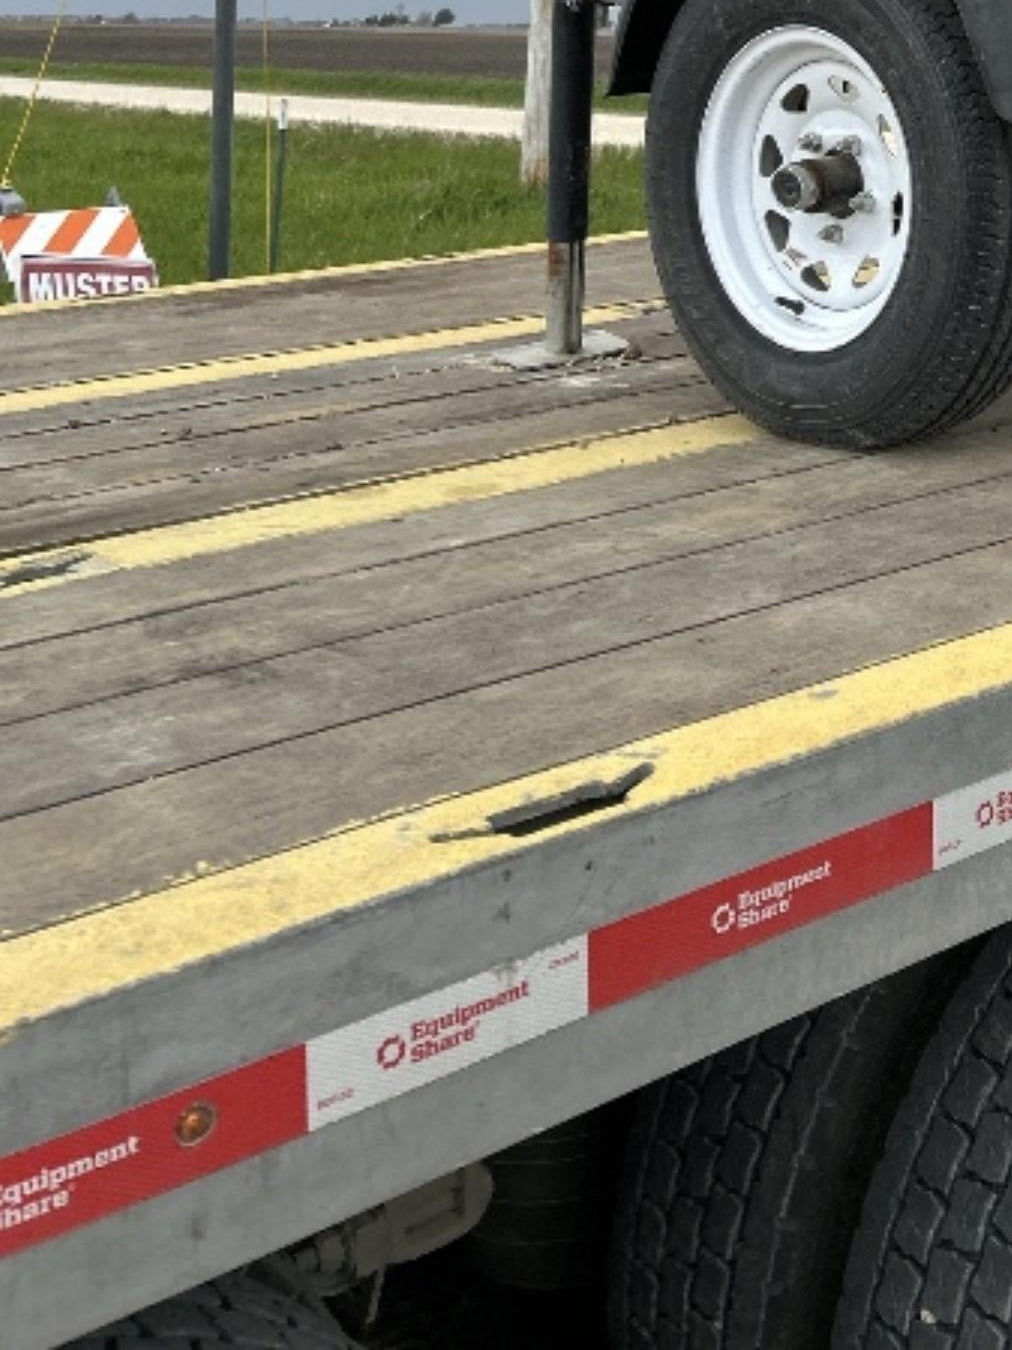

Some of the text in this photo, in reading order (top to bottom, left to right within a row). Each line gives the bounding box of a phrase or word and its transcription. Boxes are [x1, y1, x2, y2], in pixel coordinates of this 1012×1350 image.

[410, 979, 529, 1041] Equipment
[410, 1025, 475, 1063] Share
[0, 1136, 140, 1206] quipment
[0, 1190, 70, 1230] hare
